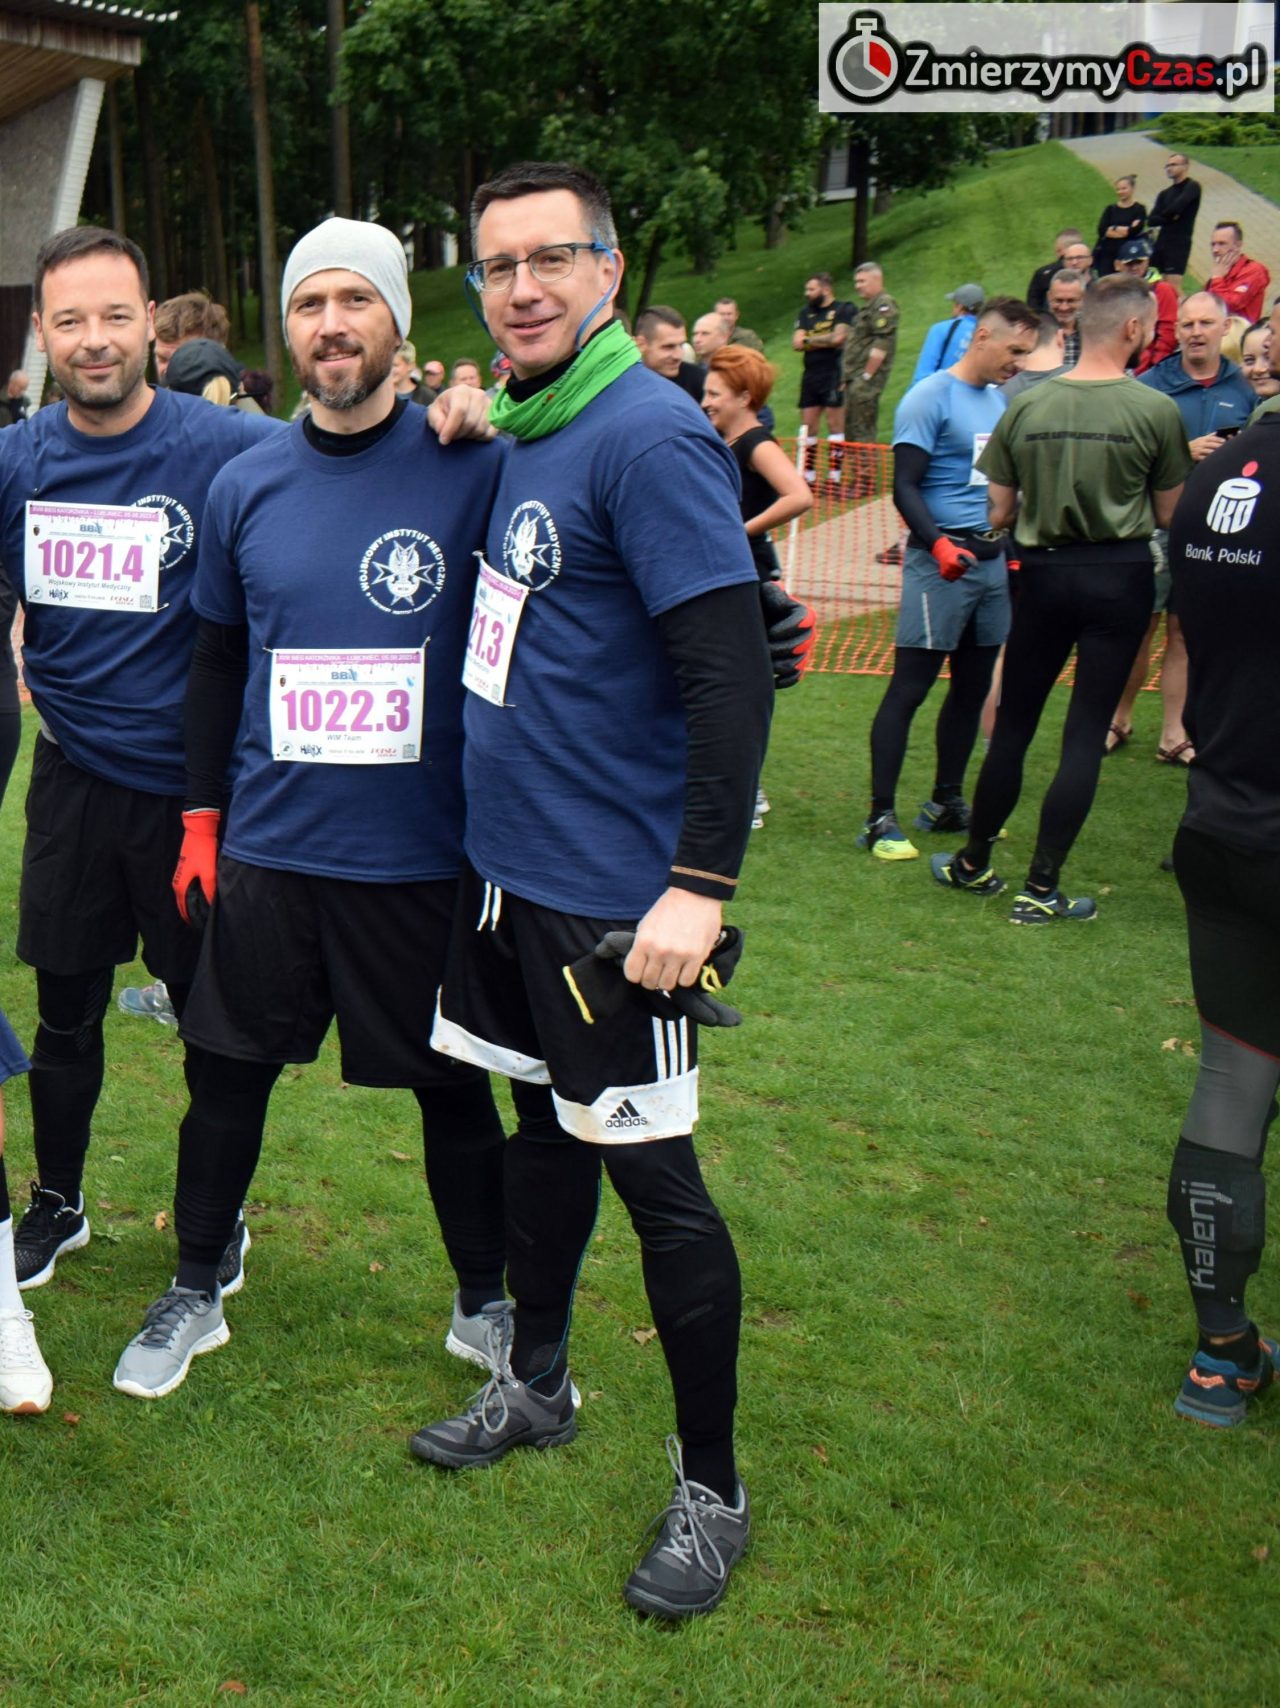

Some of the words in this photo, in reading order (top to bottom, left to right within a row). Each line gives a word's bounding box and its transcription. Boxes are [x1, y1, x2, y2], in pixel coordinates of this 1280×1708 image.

[175, 503, 194, 549] MEDYCZNY
[544, 519, 562, 576] MEDYCZNY
[38, 539, 144, 583] 1021.4
[382, 528, 431, 543] INSTYTUT
[426, 540, 446, 592] MEDYCZNY
[1185, 543, 1214, 562] Bank
[1217, 548, 1262, 566] Polski
[281, 689, 410, 732] 1022.3
[605, 1116, 648, 1128] adidas
[1181, 1180, 1233, 1290] kalenji
